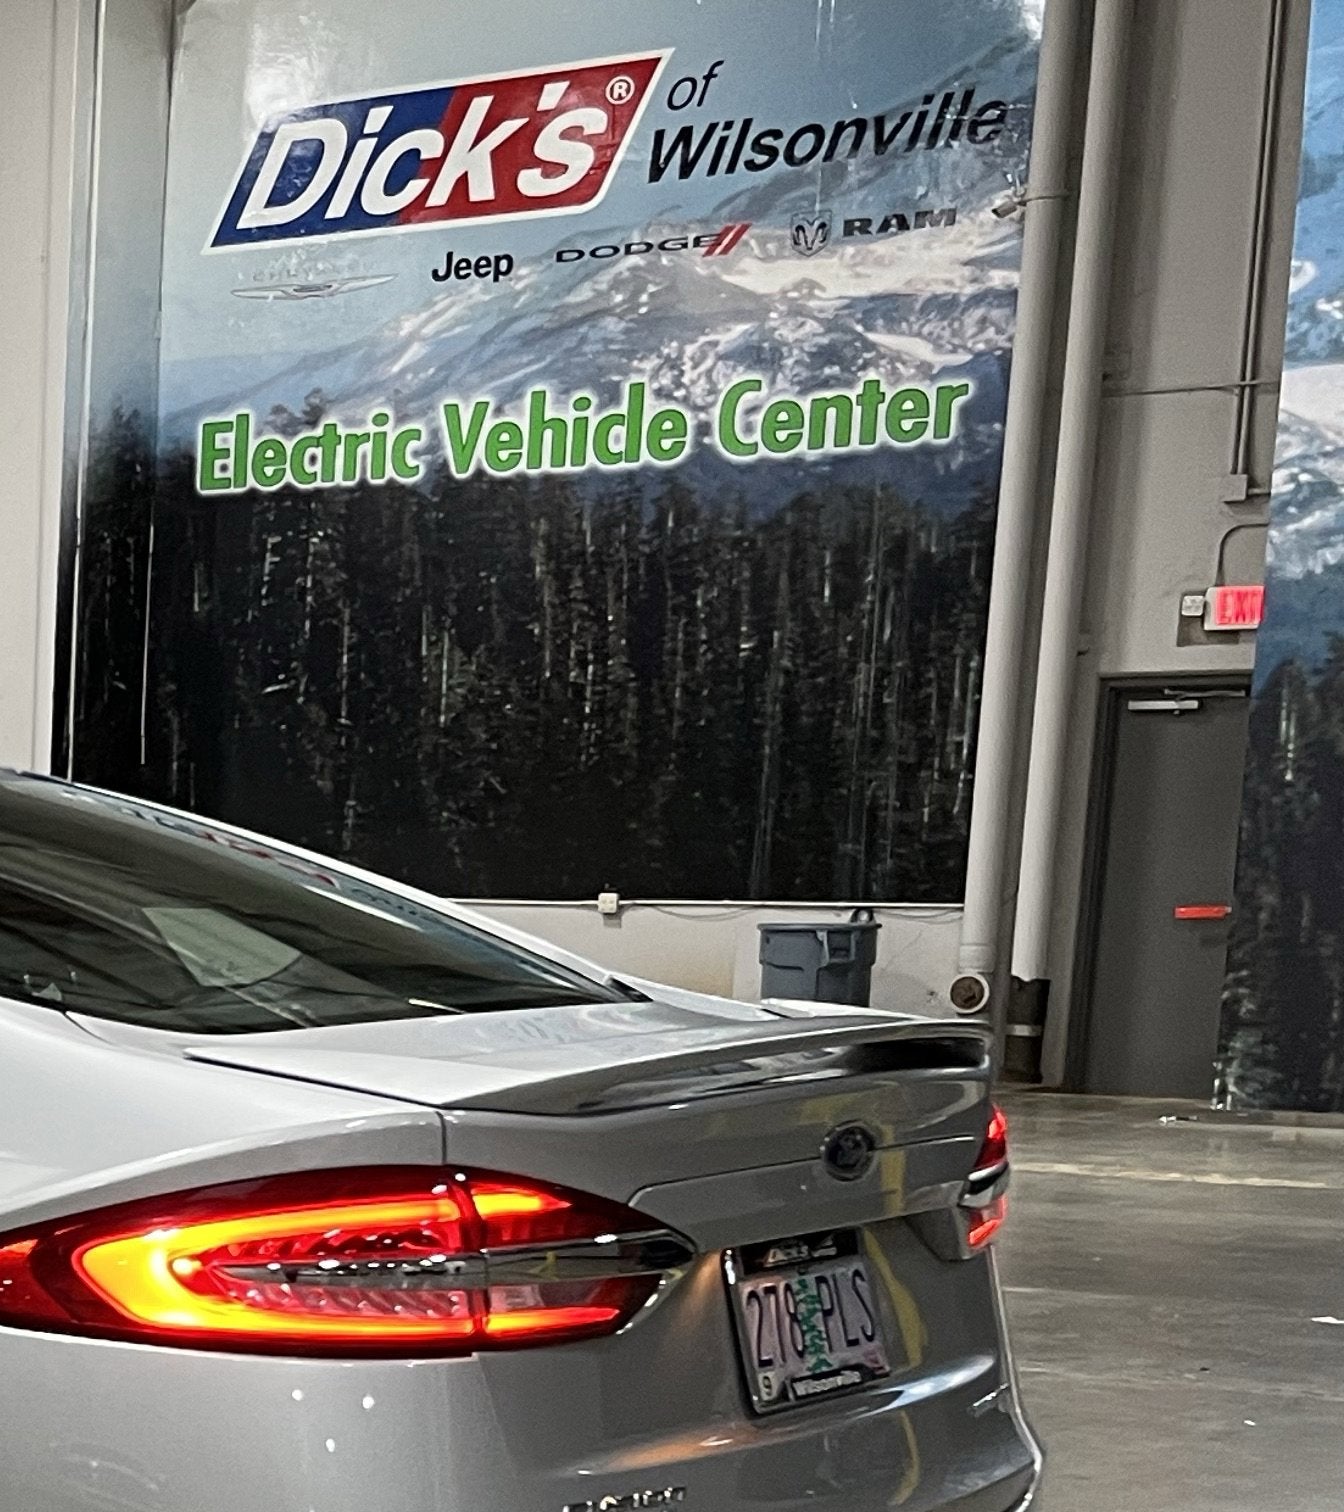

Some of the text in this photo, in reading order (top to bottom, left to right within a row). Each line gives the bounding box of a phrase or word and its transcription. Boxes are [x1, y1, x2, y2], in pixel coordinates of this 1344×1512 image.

[236, 60, 725, 231] Dick's of
[648, 87, 1008, 184] Wilsonville
[432, 251, 514, 283] Jeep
[555, 233, 721, 263] DODGE
[843, 207, 957, 238] RAM
[199, 379, 970, 491] Electric Vehicle Center
[746, 1269, 875, 1368] 278 PLS
